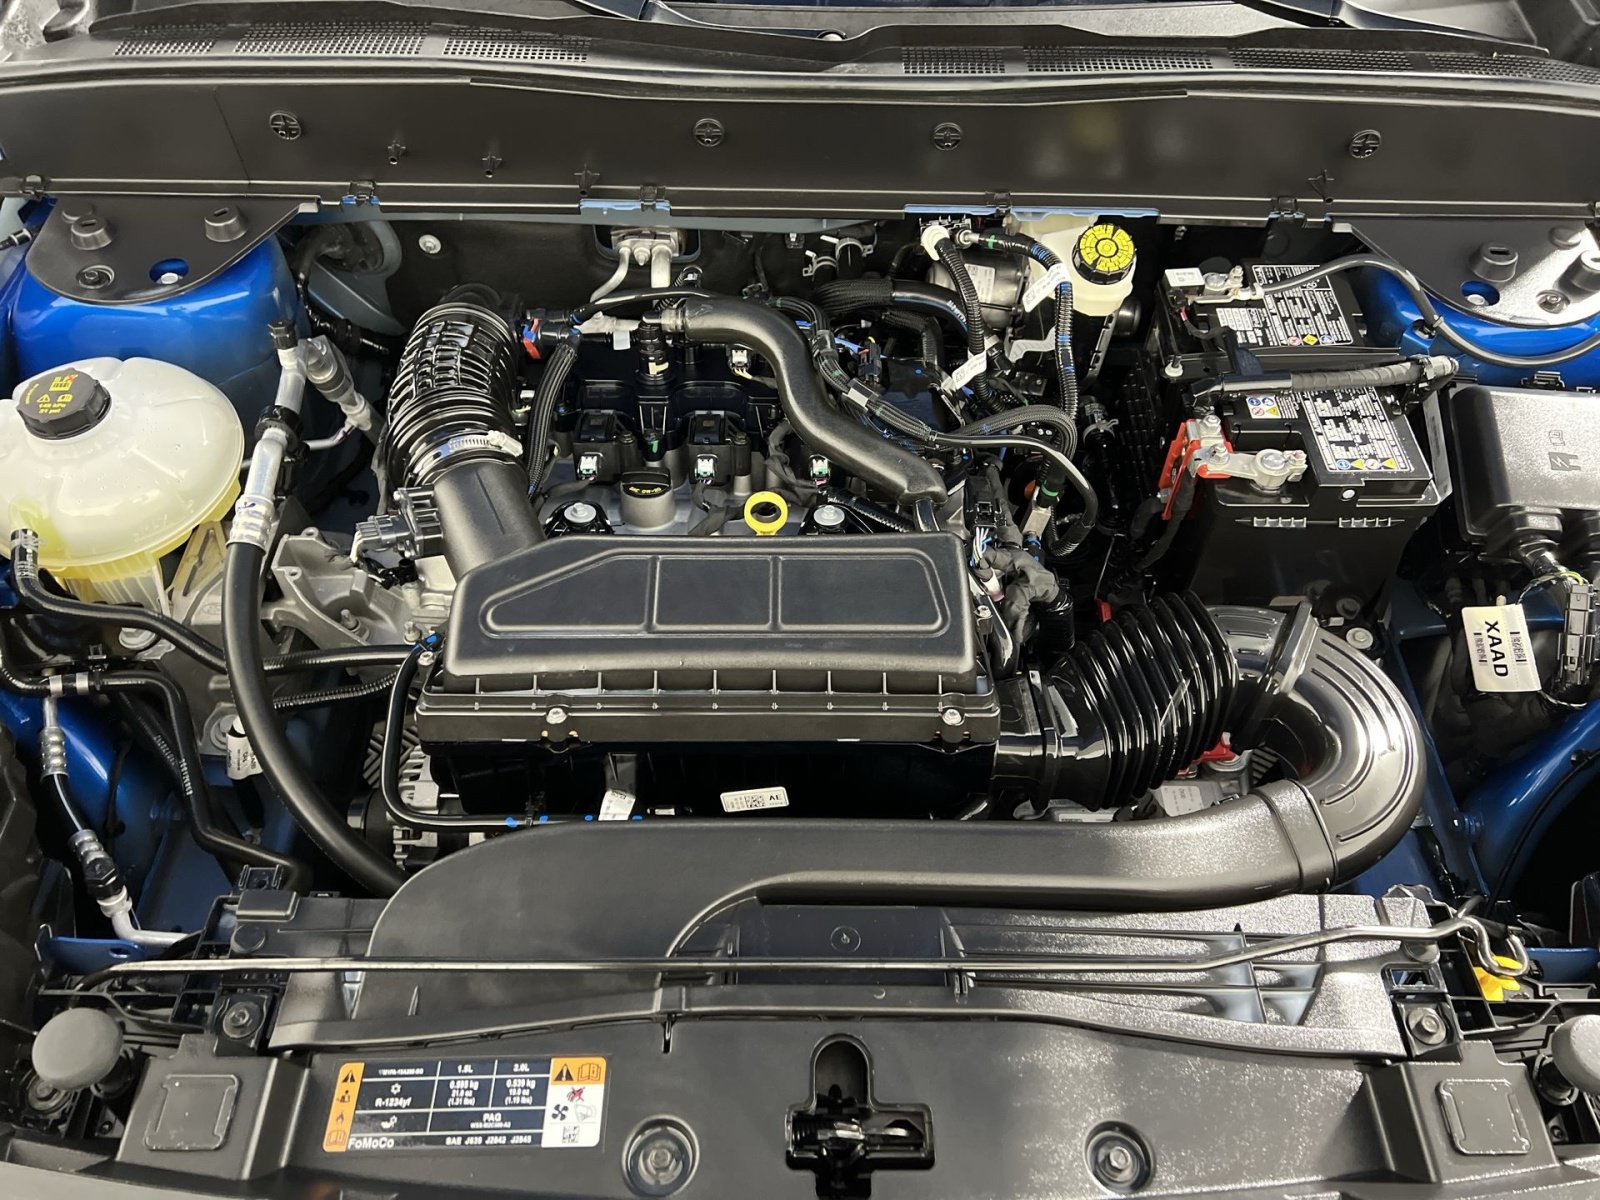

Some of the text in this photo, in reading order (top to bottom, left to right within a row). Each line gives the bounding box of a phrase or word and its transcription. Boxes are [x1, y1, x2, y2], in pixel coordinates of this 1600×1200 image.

[1485, 621, 1509, 677] XAAD
[513, 1063, 530, 1072] 2.0L
[469, 1080, 480, 1091] kg
[526, 1078, 536, 1089] kg
[374, 1097, 412, 1109] R-1234yf
[482, 1113, 502, 1122] PAG
[348, 1136, 395, 1150] FoMoCo
[445, 1136, 462, 1146] SAE
